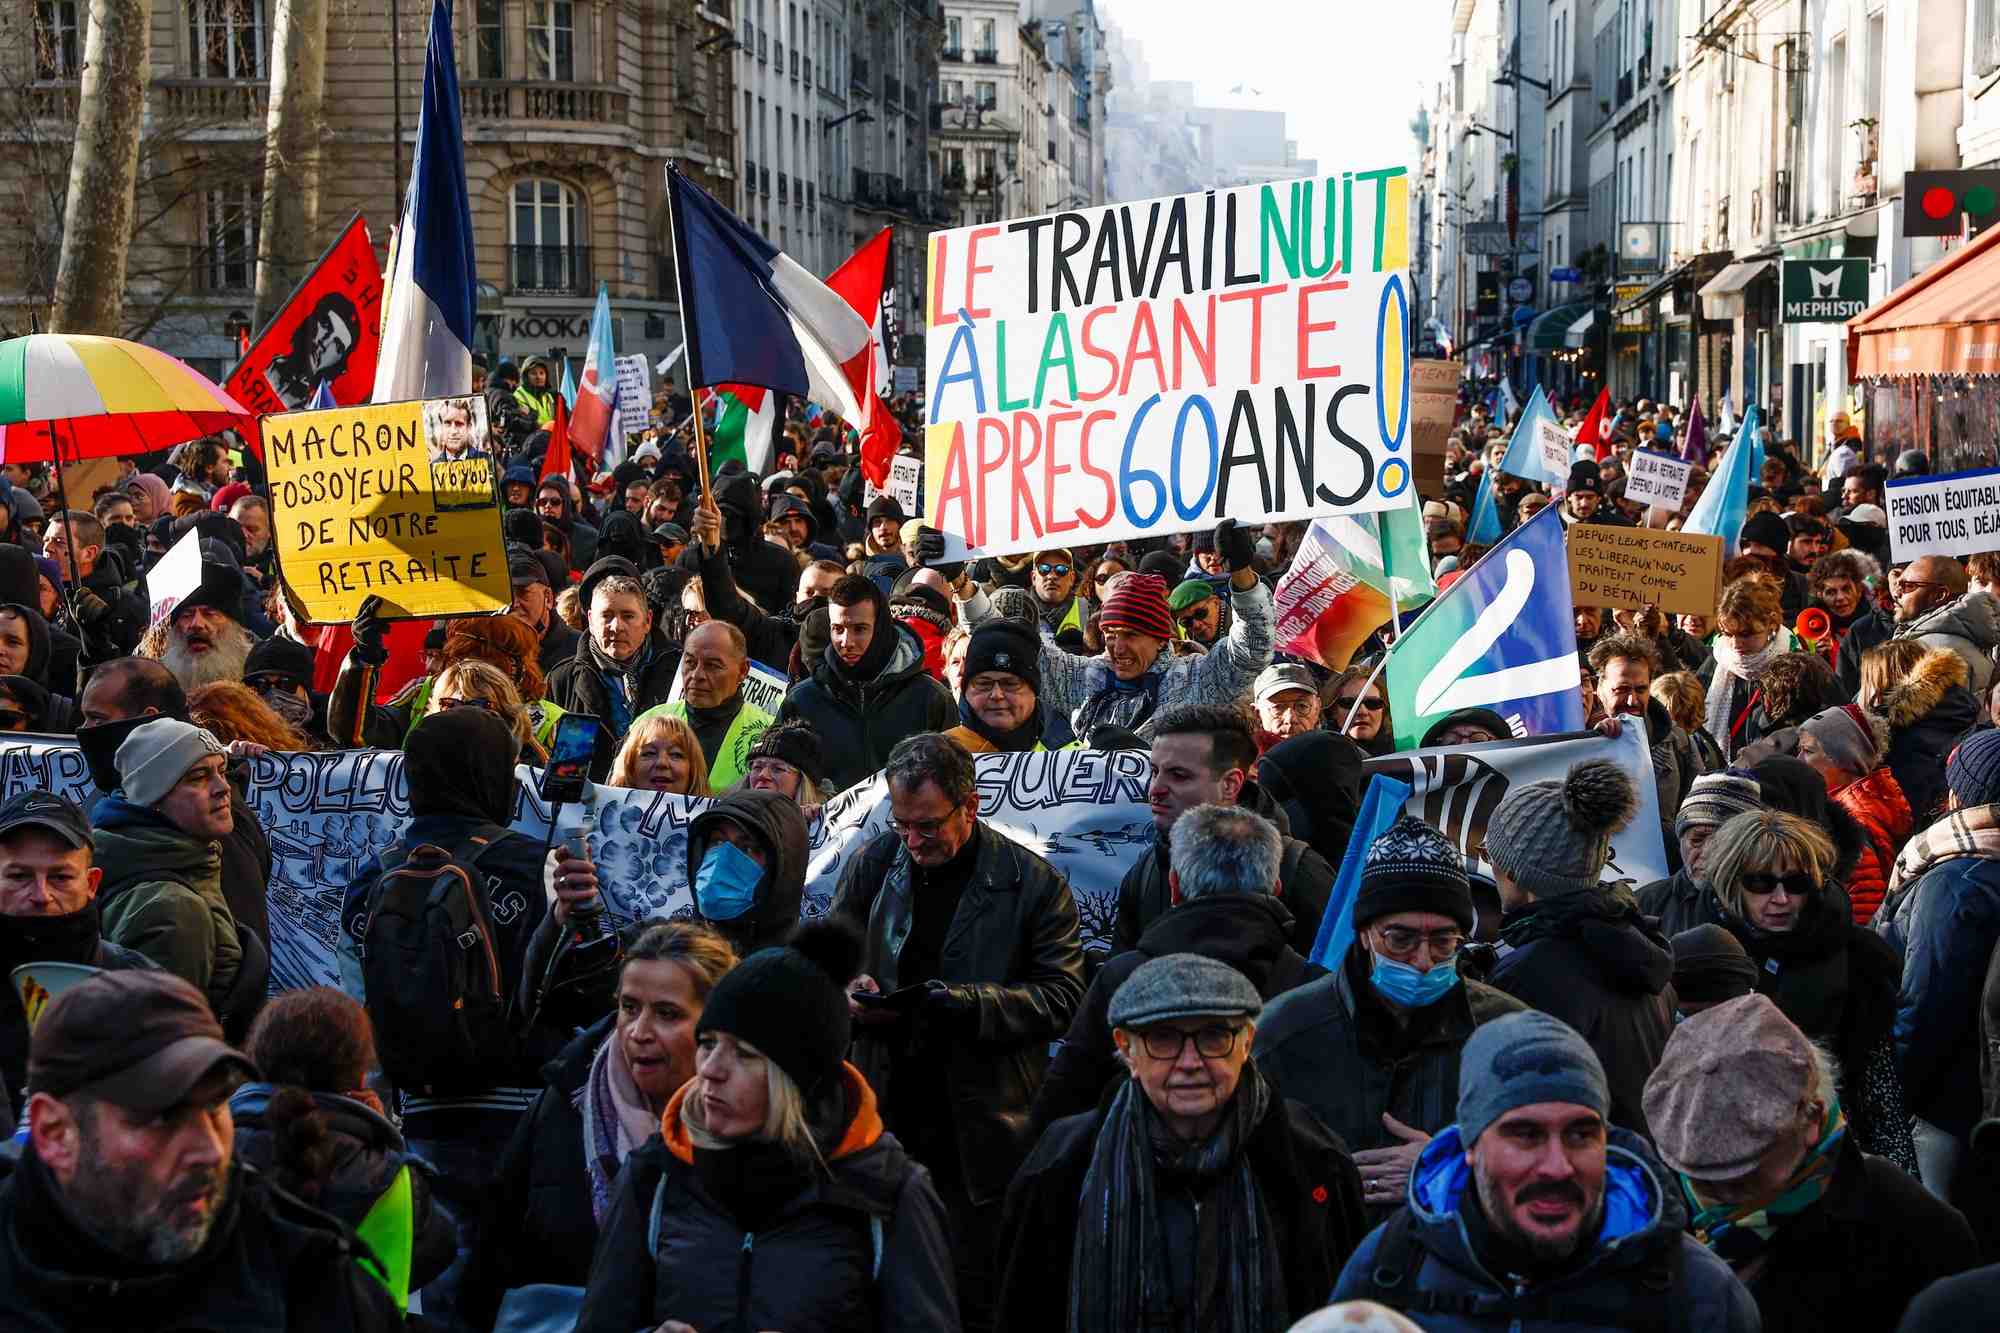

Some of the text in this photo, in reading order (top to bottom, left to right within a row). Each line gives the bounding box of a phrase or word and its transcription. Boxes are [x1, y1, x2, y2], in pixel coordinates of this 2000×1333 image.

[933, 226, 1001, 326] LE
[1008, 190, 1260, 313] TRAVAIL
[1260, 166, 1408, 284] NUIT
[1786, 300, 1865, 318] MEPHISTO
[930, 308, 986, 425] À
[996, 312, 1078, 412] LA
[1077, 260, 1349, 401] SANTÉ
[272, 420, 417, 468] MACRON
[435, 467, 488, 487] VOYOU
[934, 399, 1116, 550] APRÈS
[1119, 393, 1219, 529] 60
[1215, 383, 1375, 518] ANS
[269, 464, 420, 512] FOSSOYEUR
[1891, 486, 2000, 517] PENSION ÉQUITABL
[297, 512, 440, 551] DE NOTRE
[1575, 529, 1707, 555] DEPUIS LEURS CHATEAUX
[1899, 522, 1932, 545] POUR
[1935, 518, 1969, 540] TOUS,
[318, 551, 487, 595] RETRAITE
[1575, 547, 1593, 558] LES
[1655, 560, 1687, 577] NOUS
[1579, 581, 1597, 593] DU
[1640, 574, 1678, 591] COMME
